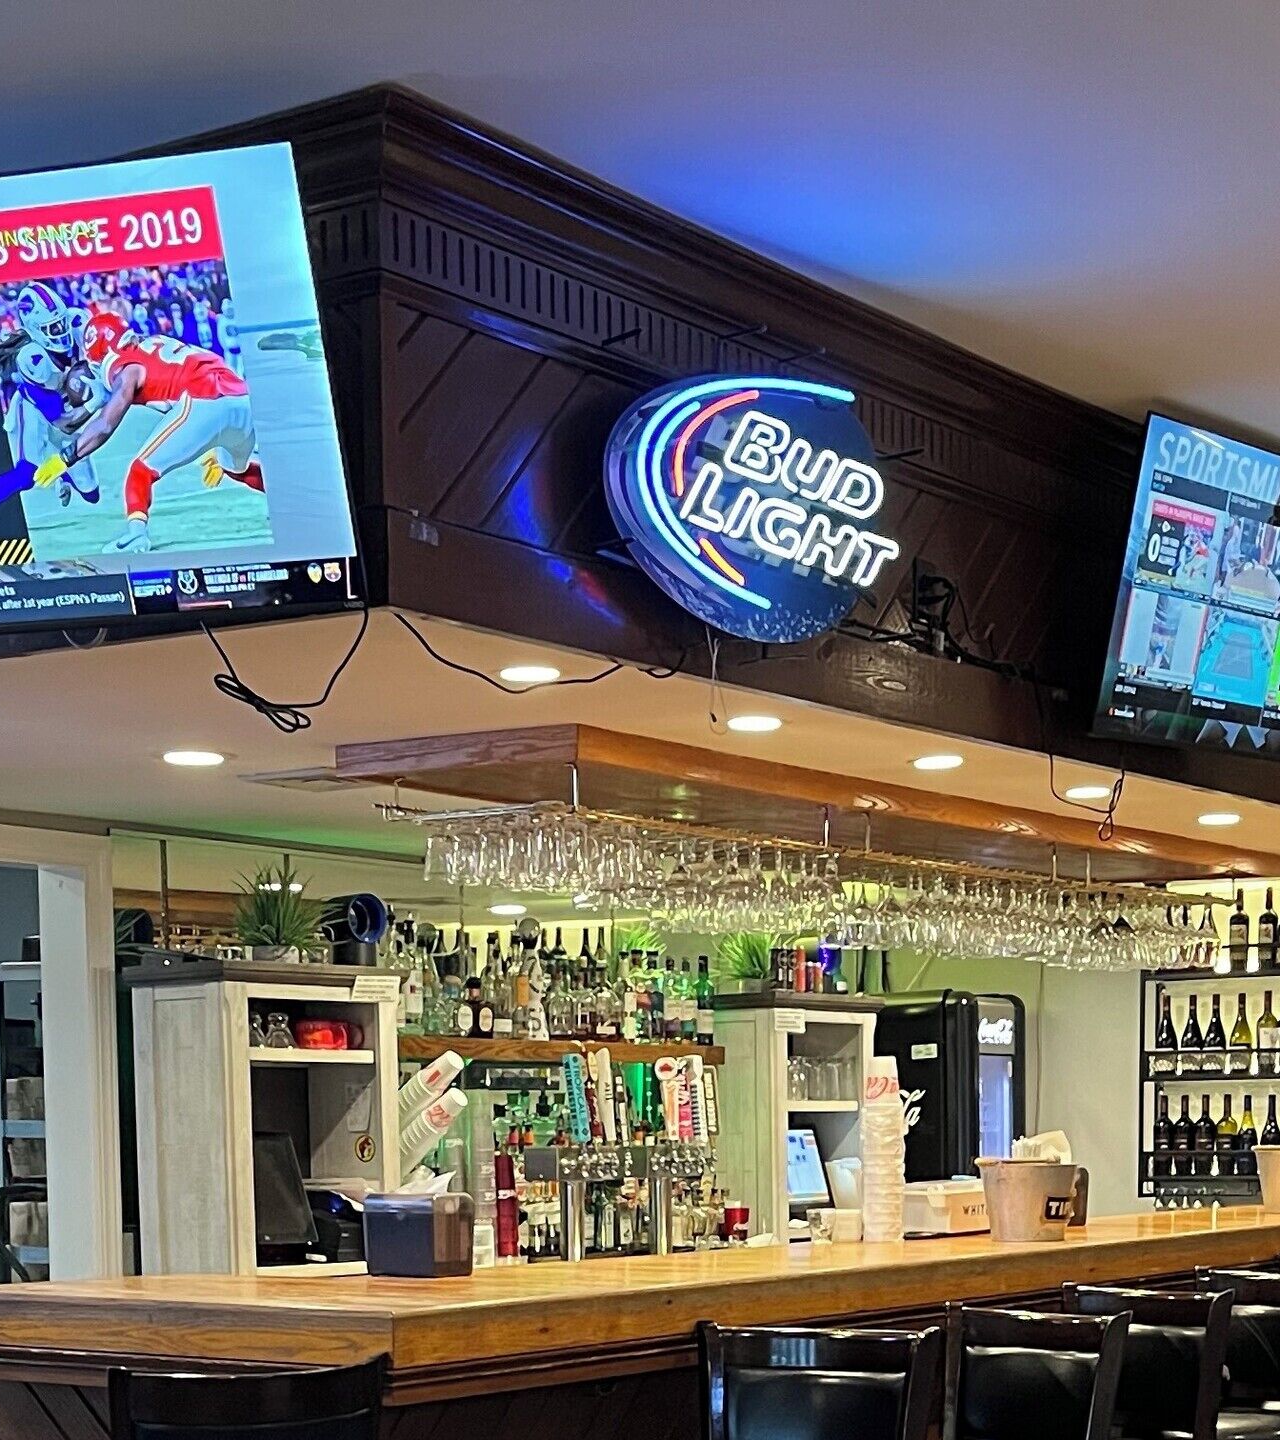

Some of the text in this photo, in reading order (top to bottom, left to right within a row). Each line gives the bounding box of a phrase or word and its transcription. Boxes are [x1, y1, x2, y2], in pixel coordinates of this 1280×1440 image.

[18, 217, 114, 262] SINCE
[120, 207, 202, 251] 2019
[723, 409, 885, 520] BUD
[679, 461, 901, 588] LIGHT
[2, 599, 22, 610] after
[36, 598, 54, 610] year
[962, 1203, 988, 1216] WHIT
